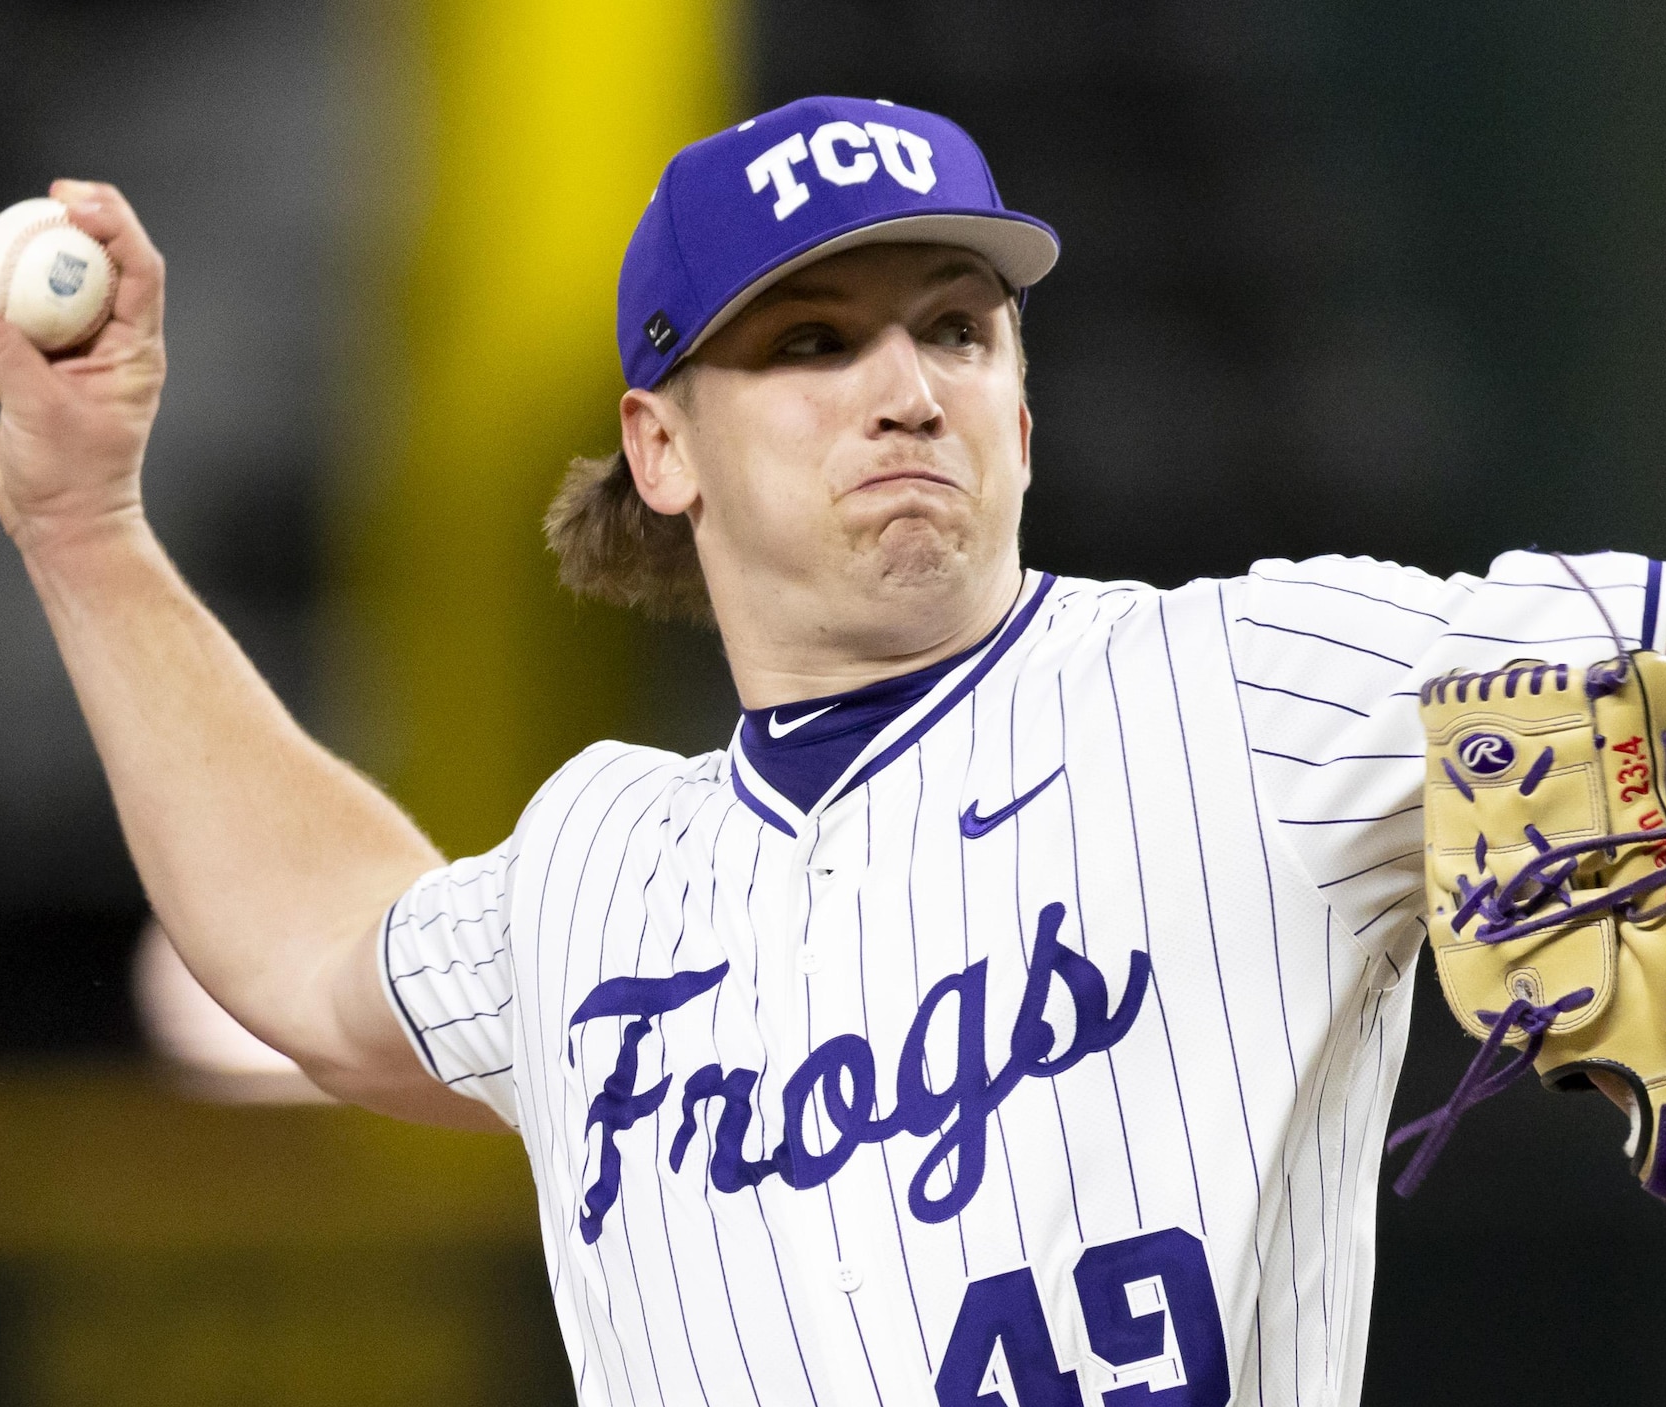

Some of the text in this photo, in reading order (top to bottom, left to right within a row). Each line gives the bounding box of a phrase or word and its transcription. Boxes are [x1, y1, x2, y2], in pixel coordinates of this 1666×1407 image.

[746, 120, 937, 221] TCU
[1612, 736, 1650, 803] 23:4
[569, 901, 1151, 1245] Frogs
